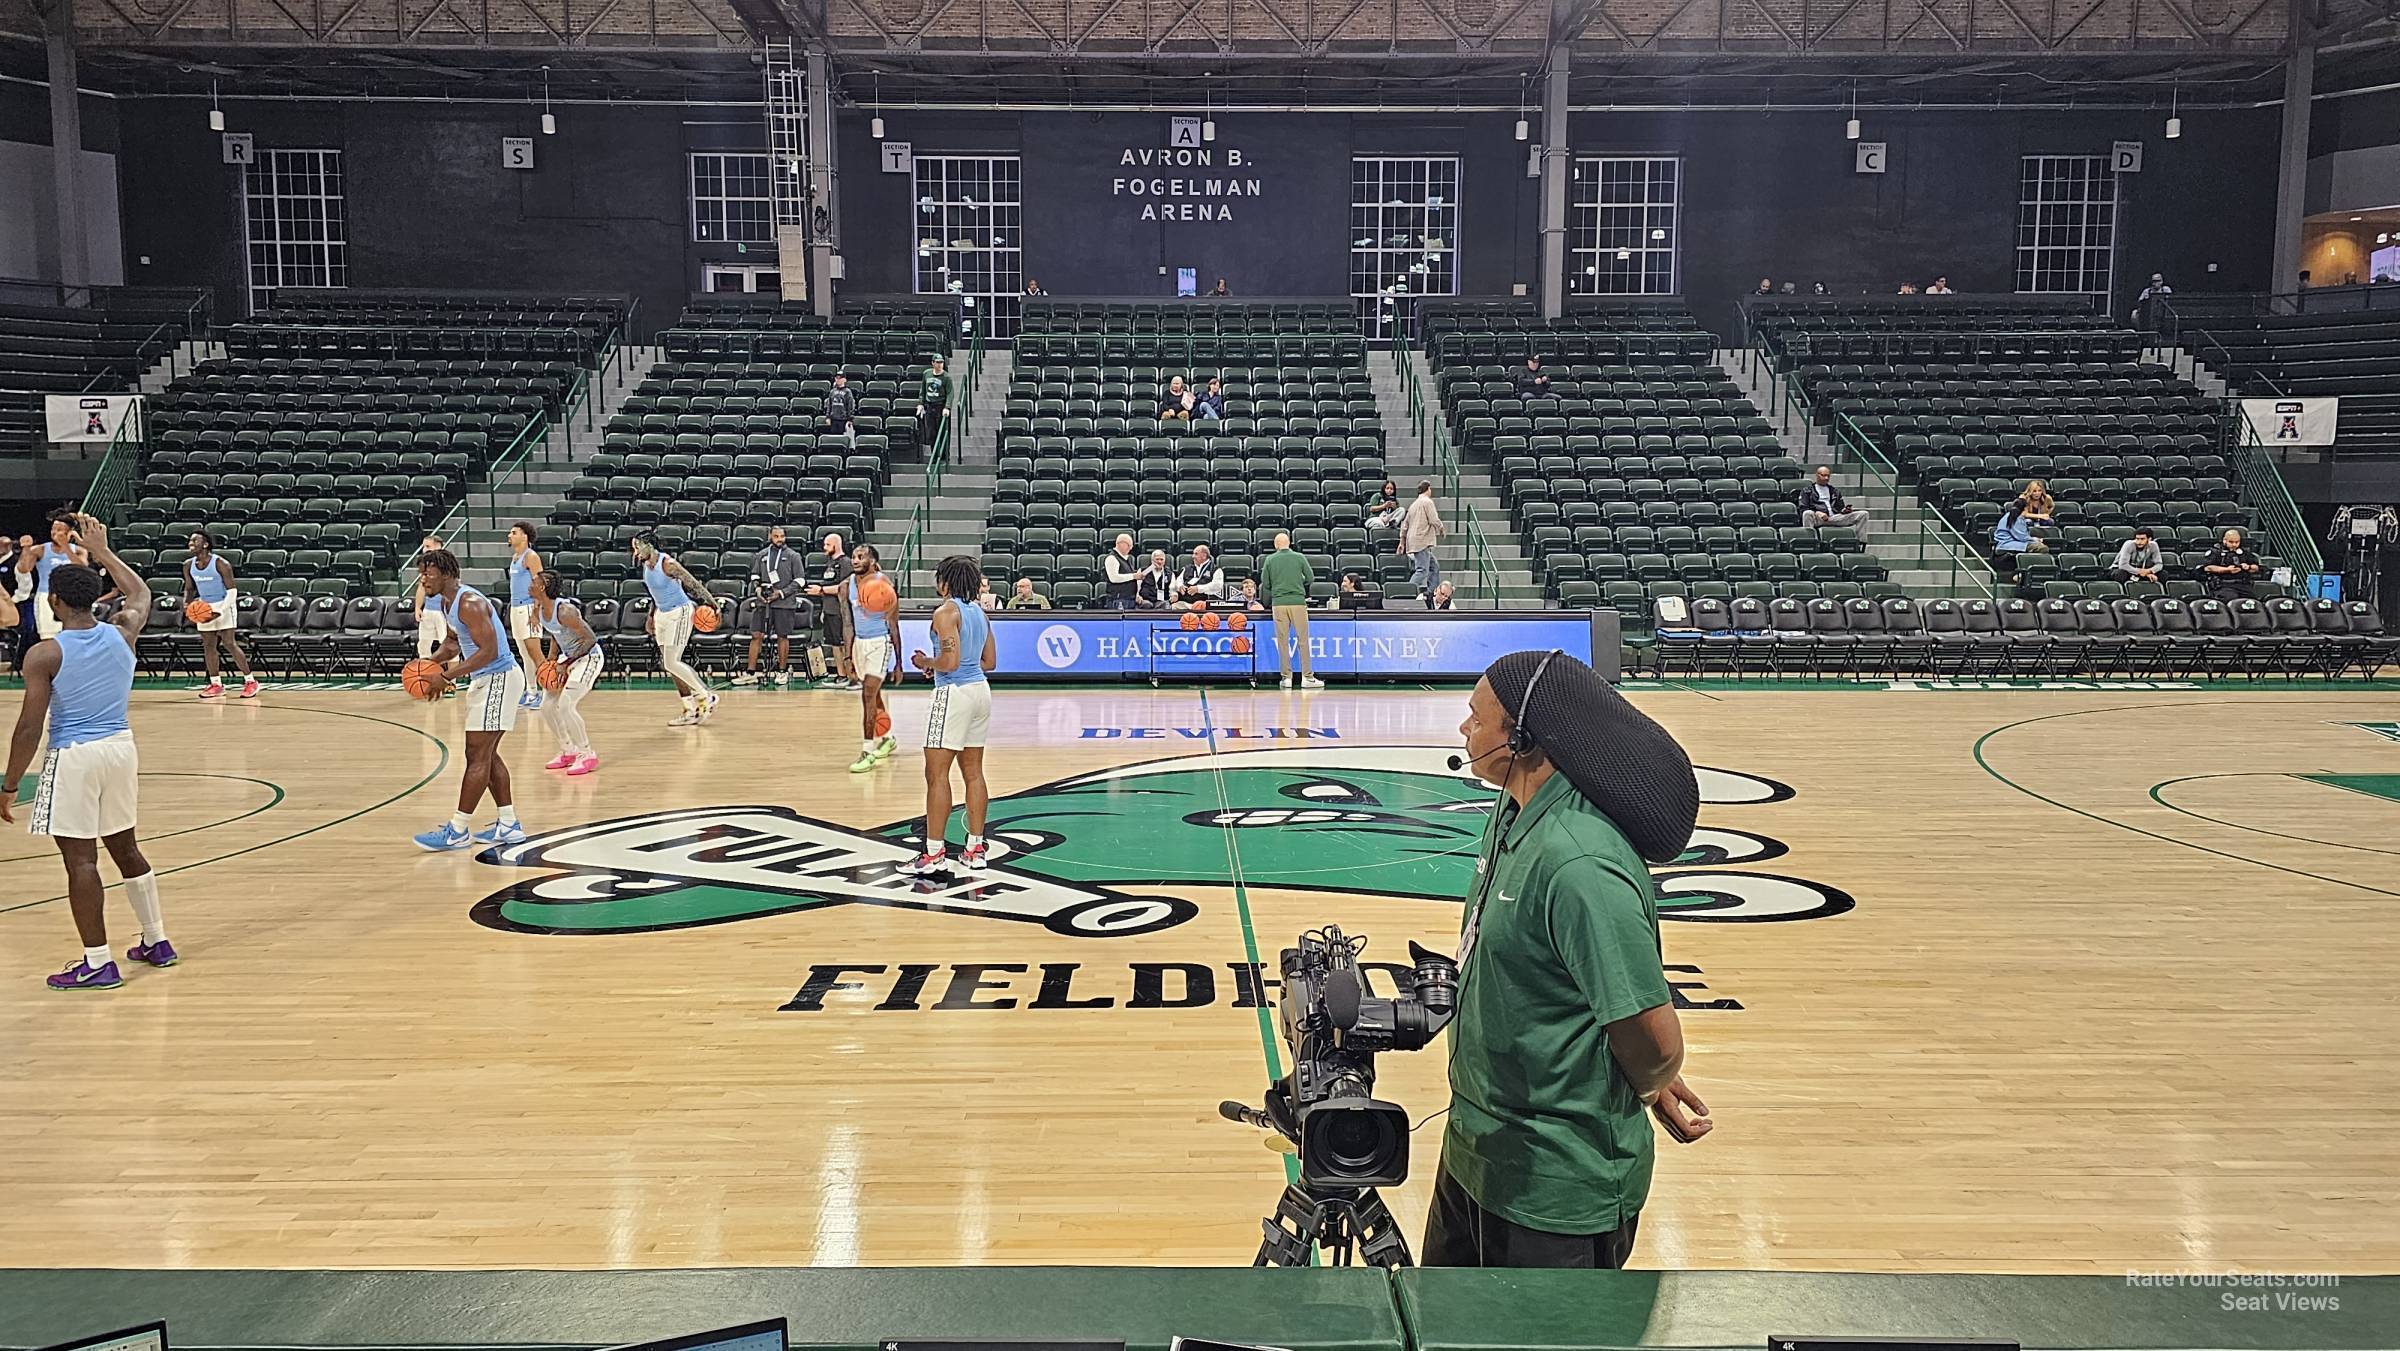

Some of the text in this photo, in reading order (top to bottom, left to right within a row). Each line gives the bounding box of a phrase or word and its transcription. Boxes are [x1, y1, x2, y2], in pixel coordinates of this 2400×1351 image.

[1178, 127, 1193, 143] A
[232, 143, 245, 160] R
[512, 147, 524, 164] S
[1120, 149, 1252, 166] AVRON B.
[890, 152, 903, 168] T
[1865, 152, 1878, 169] C
[2119, 152, 2134, 168] D
[1113, 178, 1261, 196] FOGELMAN
[1140, 204, 1233, 221] ARENA
[1077, 727, 1341, 738] DEVLIN
[886, 1342, 898, 1351] 4K
[1782, 1342, 1795, 1351] 4K
